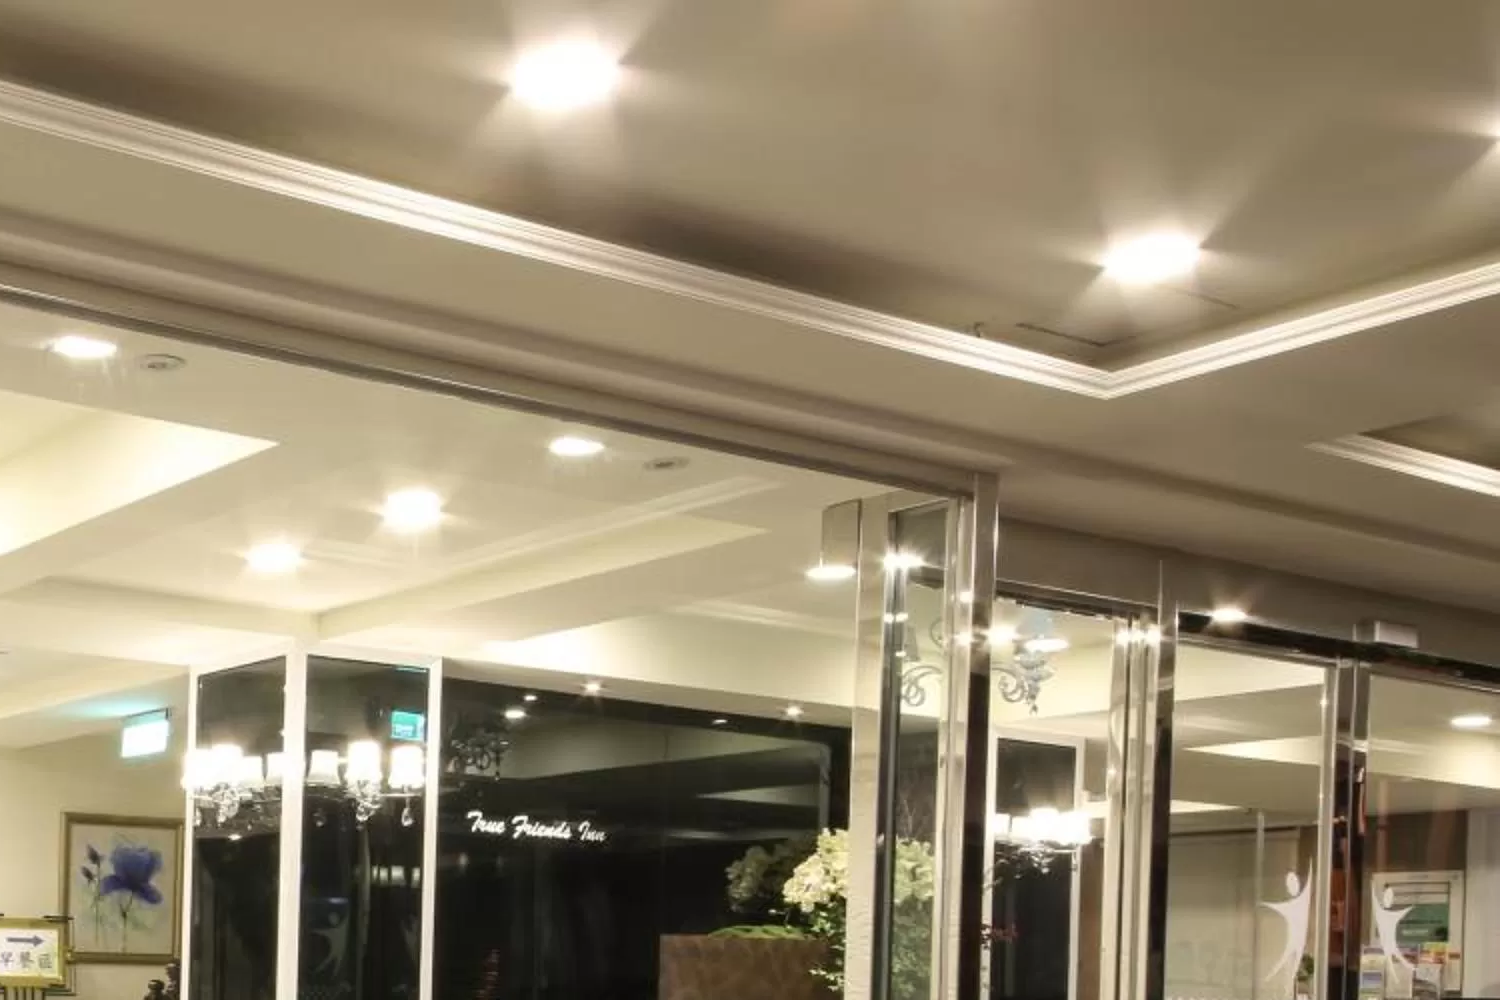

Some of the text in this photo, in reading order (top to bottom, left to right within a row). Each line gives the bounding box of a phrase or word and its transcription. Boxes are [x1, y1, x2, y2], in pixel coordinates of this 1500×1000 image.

[467, 811, 607, 842] True Friends Inn
